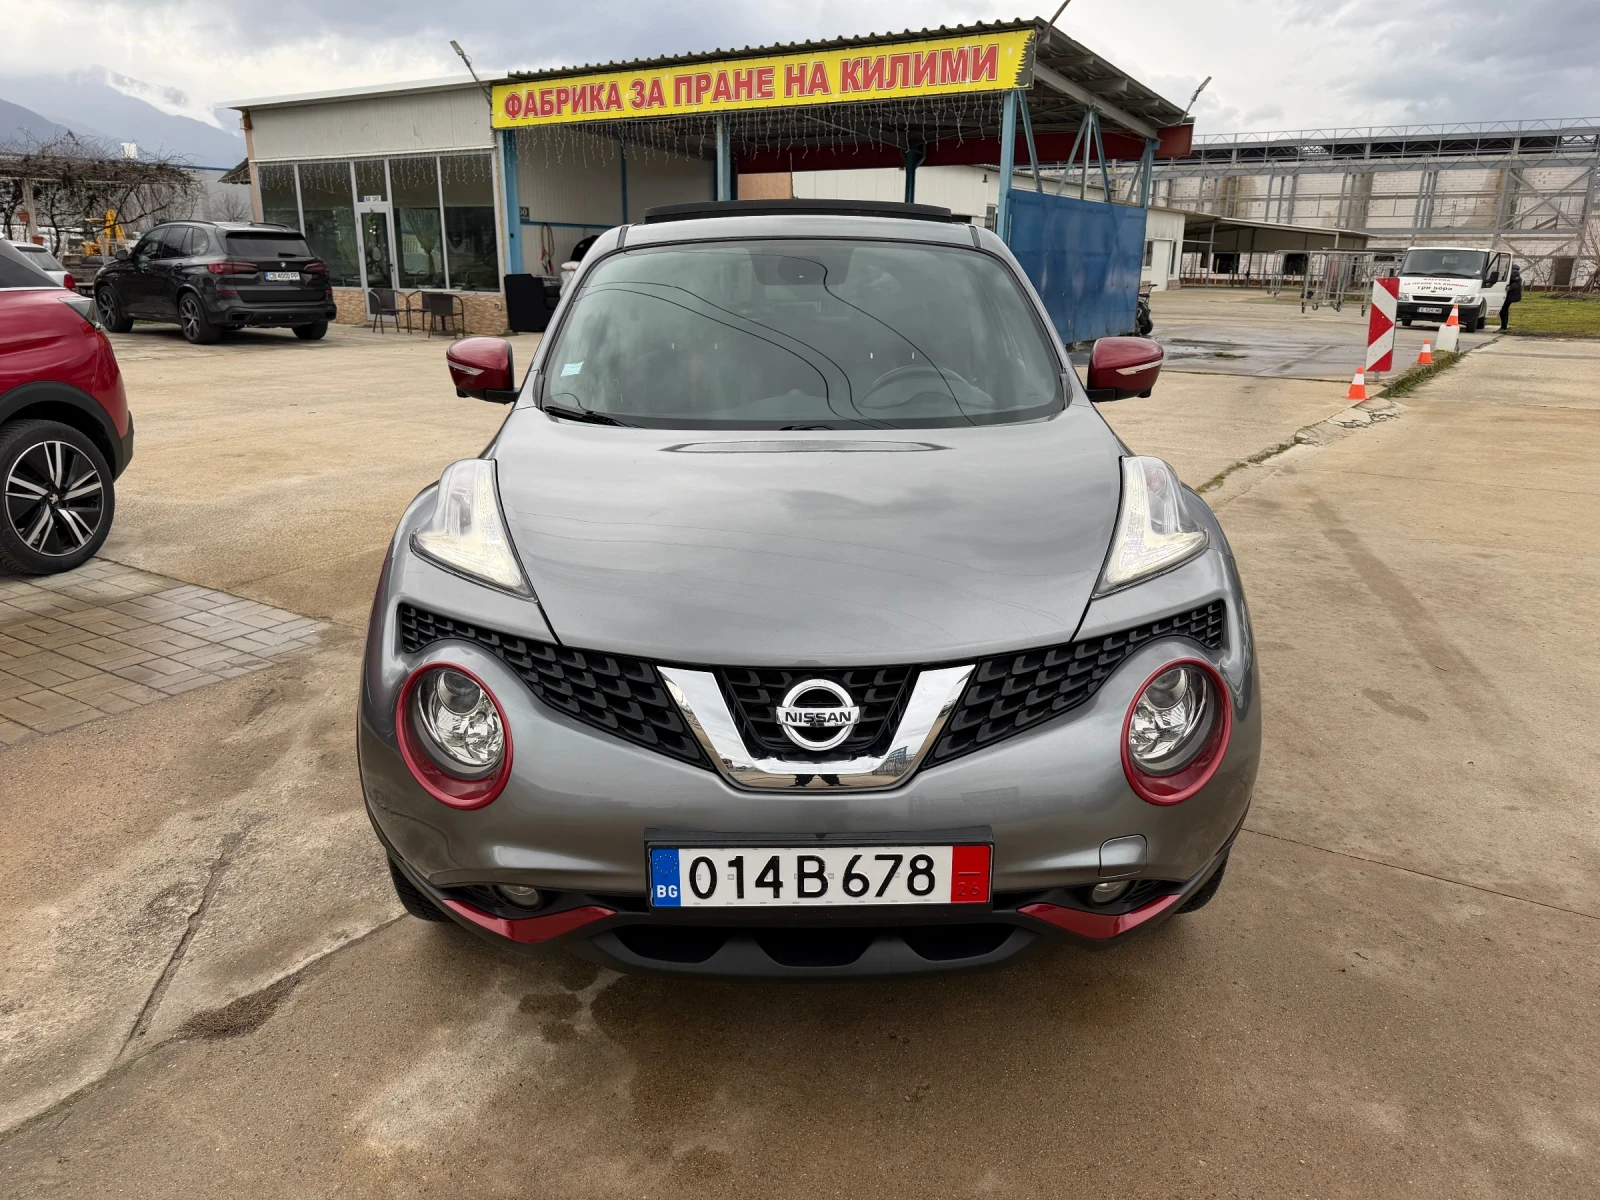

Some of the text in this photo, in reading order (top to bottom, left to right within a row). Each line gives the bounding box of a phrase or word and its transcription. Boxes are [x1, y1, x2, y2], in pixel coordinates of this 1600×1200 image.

[505, 44, 999, 120] ФАБРИКА ЗА ПРАНЕ НА КИЛИМИ
[785, 711, 851, 722] NISSAN
[656, 884, 678, 898] BG
[958, 881, 980, 896] 26
